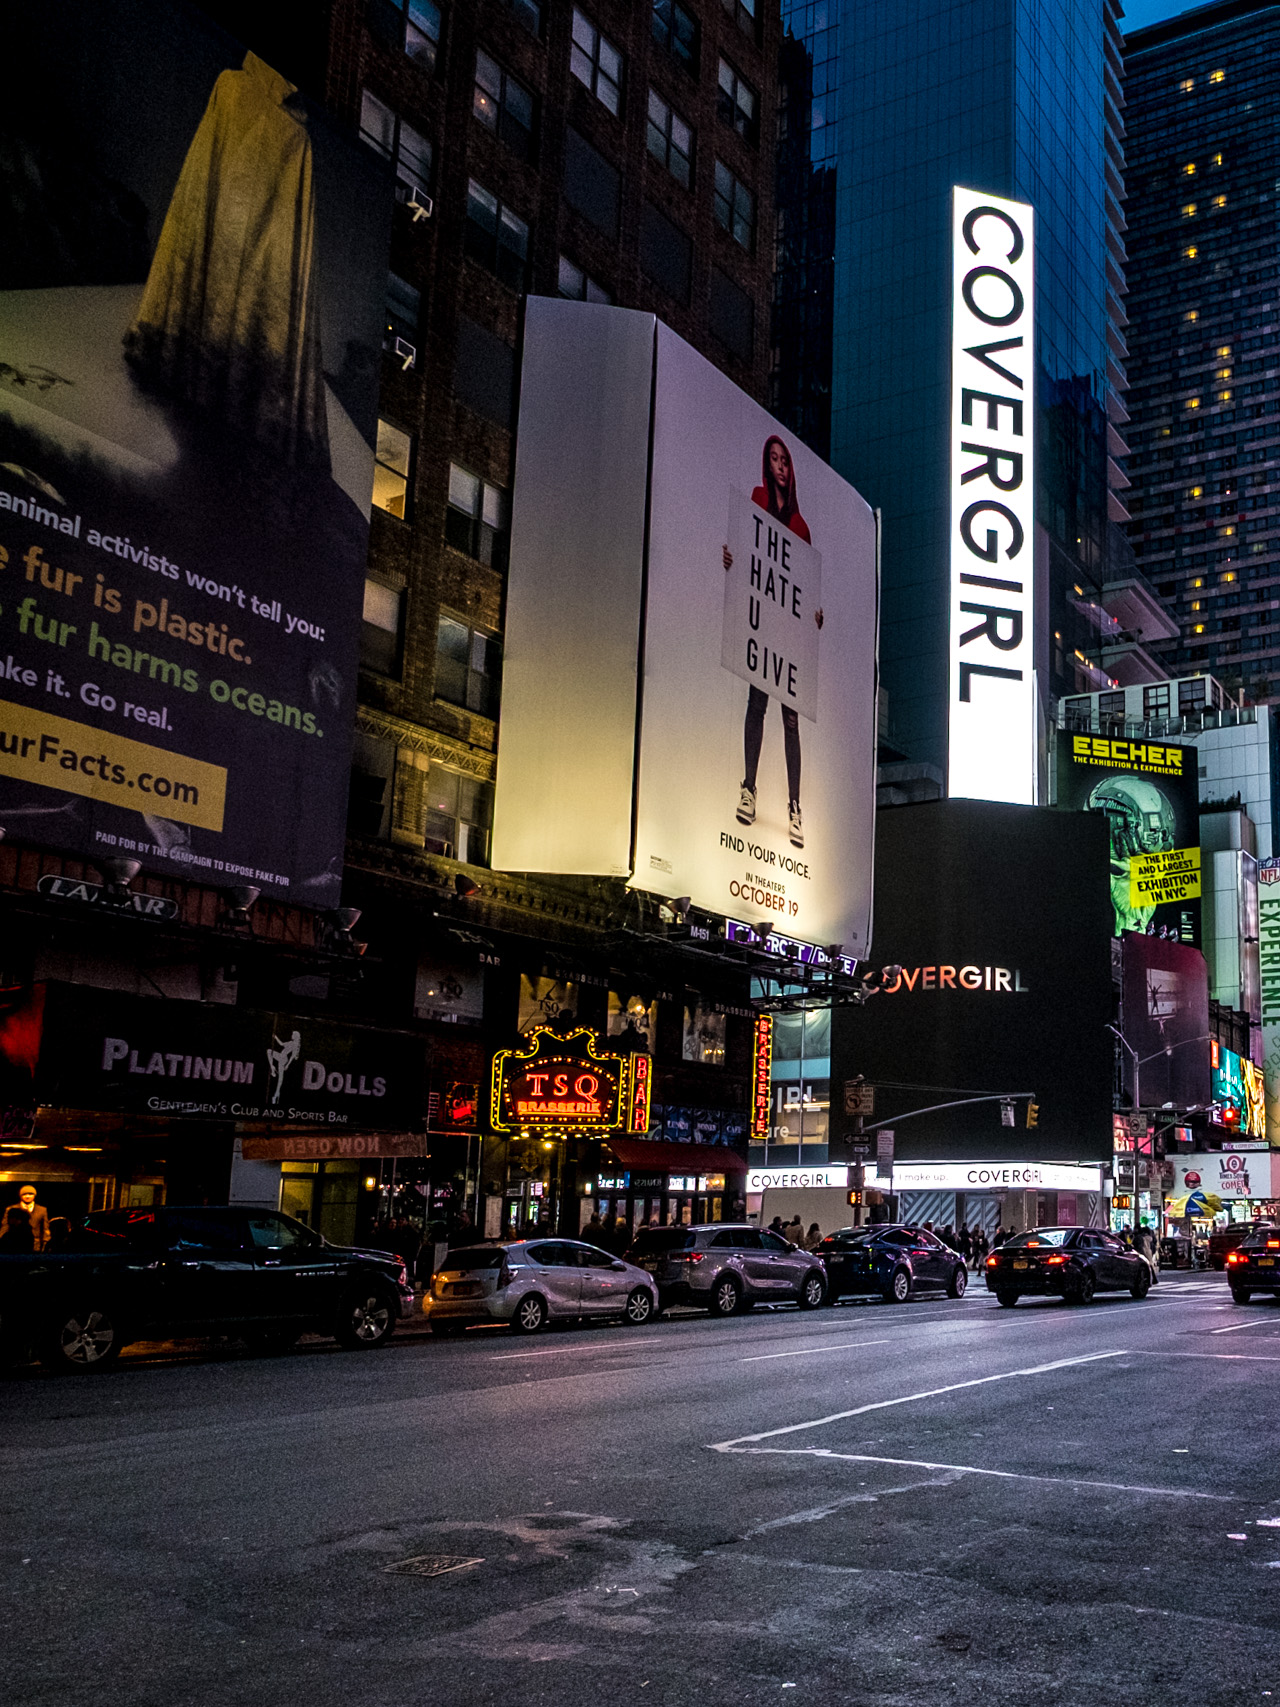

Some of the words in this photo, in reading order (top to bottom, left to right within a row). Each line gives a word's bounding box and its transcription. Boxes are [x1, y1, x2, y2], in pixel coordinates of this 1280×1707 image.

[958, 205, 1025, 704] COVERGIRL
[751, 513, 792, 572] THE
[0, 490, 82, 539] animal
[86, 528, 181, 581] activists
[185, 568, 247, 610] won't
[250, 594, 282, 624] tell
[286, 609, 326, 642] you:
[22, 545, 84, 597] fur
[93, 573, 123, 614] is
[133, 597, 252, 665] plastic.
[750, 554, 802, 620] HATE
[749, 595, 760, 632] U
[16, 597, 78, 648] fur
[88, 620, 199, 693] harms
[209, 678, 324, 738] oceans.
[746, 637, 799, 698] GIVE
[46, 669, 72, 699] it.
[79, 682, 117, 712] Go
[123, 701, 173, 732] real.
[1073, 735, 1183, 767] ESCHER
[1073, 755, 1088, 764] THE
[1089, 757, 1131, 769] EXHIBITION
[1140, 764, 1183, 776] EXPERIENCE
[96, 831, 116, 845] PAID
[119, 835, 136, 851] FOR
[138, 840, 150, 854] BY
[152, 845, 168, 858] THE
[169, 849, 212, 869] CAMPAIGN
[213, 859, 224, 870] TO
[225, 861, 255, 878] EXPOSE
[255, 869, 274, 883] FAKE
[275, 873, 290, 887] FUR
[719, 831, 745, 853] FIND
[747, 842, 776, 866] YOUR
[778, 854, 811, 880] VOICE.
[1138, 865, 1155, 875] AND
[1157, 859, 1193, 872] LARGEST
[1144, 854, 1161, 865] THE
[1162, 851, 1185, 862] FIRST
[745, 872, 753, 883] IN
[755, 875, 785, 894] THEATERS
[1136, 872, 1198, 892] EXHIBITION
[1259, 866, 1280, 883] NFL
[729, 880, 785, 913] OCTOBER
[788, 900, 799, 917] 19
[1150, 890, 1164, 903] IN
[1165, 887, 1187, 900] NYC
[478, 952, 501, 967] BAR
[101, 1036, 255, 1085] PLATINUM
[301, 1060, 388, 1098] DOLLS
[756, 1019, 768, 1133] BRASSERIE
[526, 1073, 599, 1103] TSQ
[634, 1057, 648, 1131] BAR
[768, 1085, 821, 1113] IRL
[230, 1102, 259, 1117] CLUB
[262, 1108, 285, 1119] AND
[287, 1107, 325, 1122] SPORTS
[328, 1111, 349, 1124] BAR
[517, 1101, 601, 1113] BRASSERIE
[751, 1173, 833, 1188] COVERGIRL
[1221, 1180, 1249, 1190] COME
